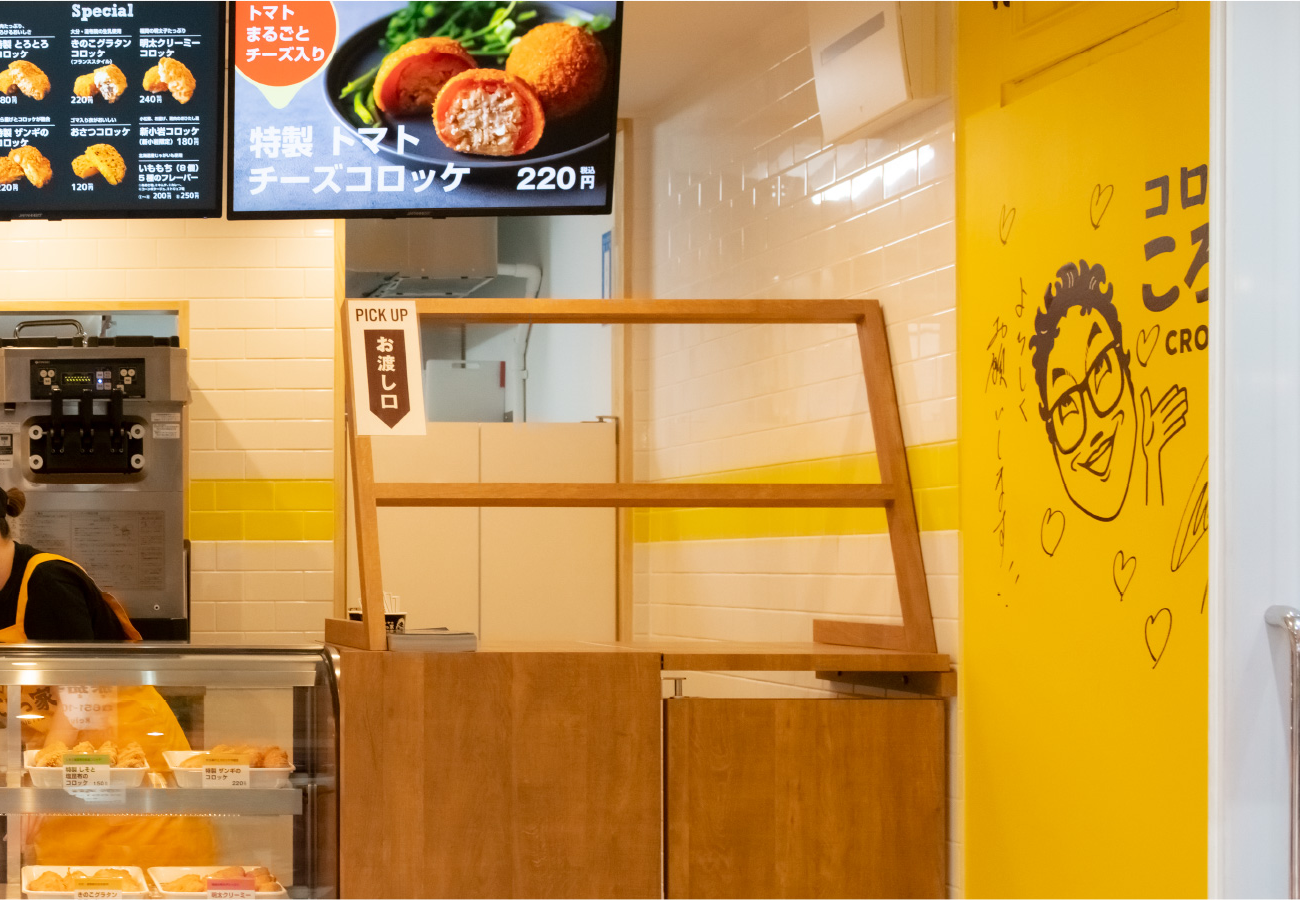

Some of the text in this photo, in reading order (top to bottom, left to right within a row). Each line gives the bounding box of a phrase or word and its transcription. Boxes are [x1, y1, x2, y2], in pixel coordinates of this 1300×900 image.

[72, 4, 134, 21] Special
[248, 4, 294, 21] トマト
[246, 26, 309, 42] まるごと
[14, 40, 49, 49] とろとろ
[71, 39, 132, 48] きのこグラタン
[140, 38, 200, 48] 明太クリーミー
[140, 49, 174, 57] コロッケ
[246, 47, 325, 62] チーズ入り
[14, 128, 49, 137] ザンギの
[71, 127, 130, 136] おさつコロッケ
[140, 127, 199, 136] 新小岩コロッケ
[249, 125, 420, 159] 特製 トマト
[248, 162, 470, 195] チーズコロッケ
[356, 308, 408, 321] PICK UP
[376, 336, 398, 409] お渡し口
